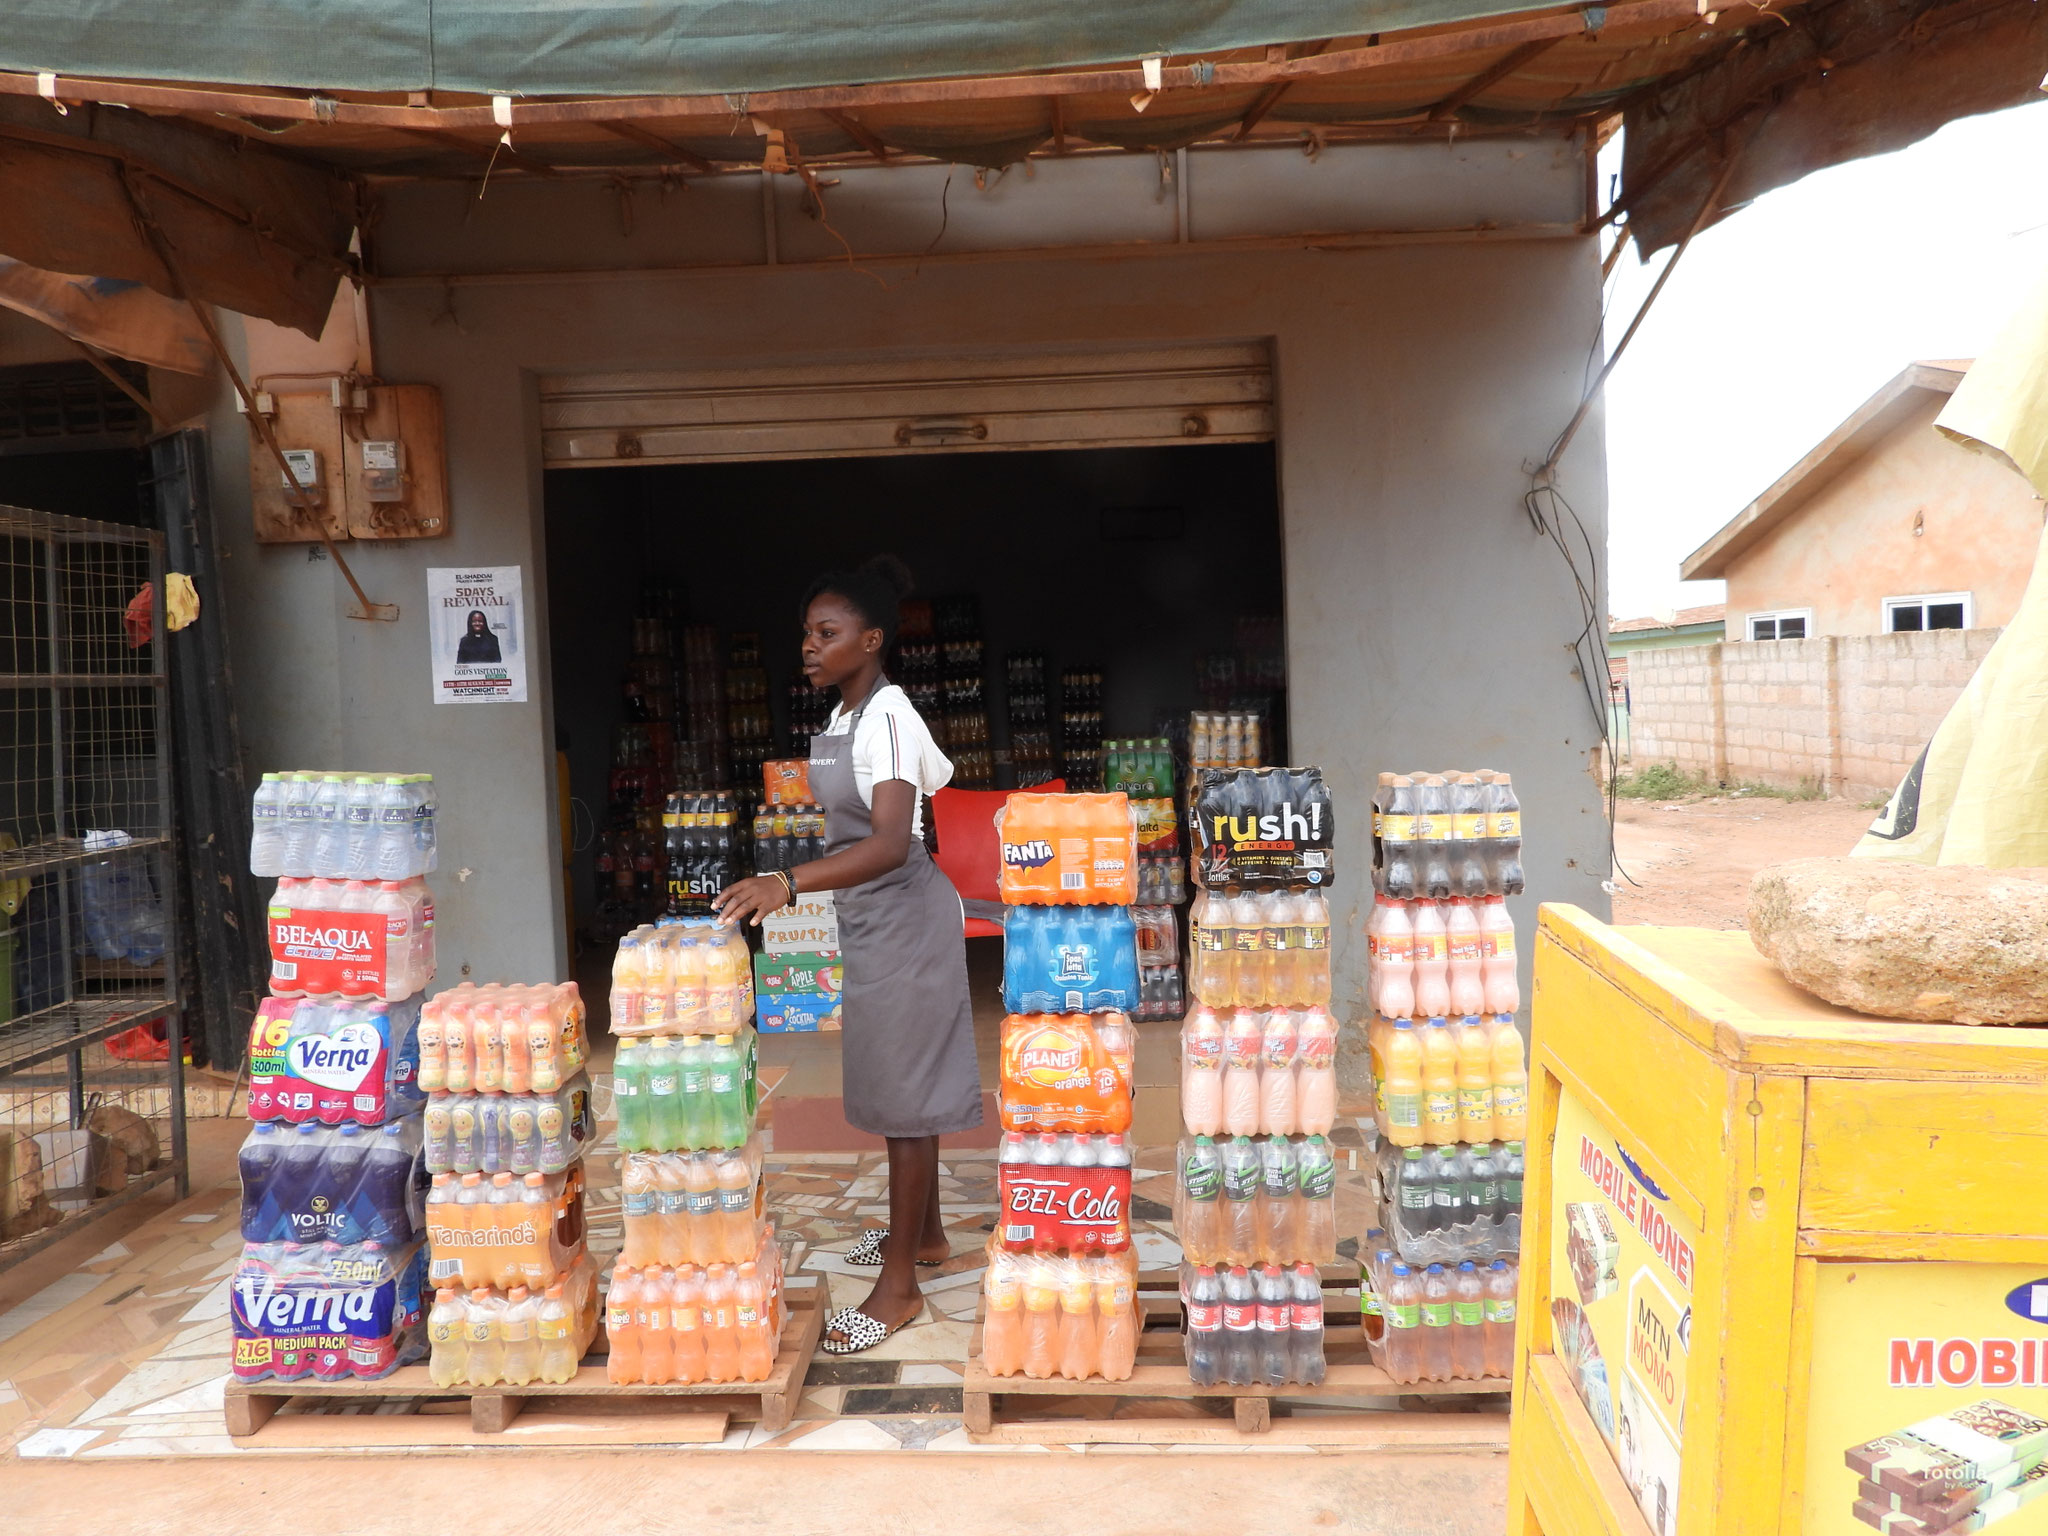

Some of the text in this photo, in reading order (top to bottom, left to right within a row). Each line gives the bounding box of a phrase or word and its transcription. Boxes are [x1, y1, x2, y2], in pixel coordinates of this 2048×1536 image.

[443, 596, 510, 608] REVIVAL
[1213, 801, 1322, 842] rush!
[1003, 840, 1054, 863] FANTA
[668, 874, 721, 895] rush!
[767, 903, 826, 918] RUITY
[767, 928, 829, 943] FRUITY
[791, 970, 815, 987] APPLE
[252, 1015, 293, 1047] 16
[251, 1047, 287, 1058] Bottles
[297, 1040, 370, 1072] Verna
[1023, 1050, 1079, 1068] PLANET
[1054, 1075, 1092, 1090] orange
[1579, 1134, 1637, 1224] MOBILE
[291, 1212, 346, 1228] VOLTIC
[331, 1258, 384, 1282] 750ml
[235, 1276, 377, 1333] Verna
[273, 1324, 322, 1334] MINERAL WATER
[1638, 1297, 1671, 1362] MTN
[274, 1336, 317, 1351] MEDIUM
[319, 1336, 348, 1350] PACK
[1633, 1325, 1675, 1405] MOMO
